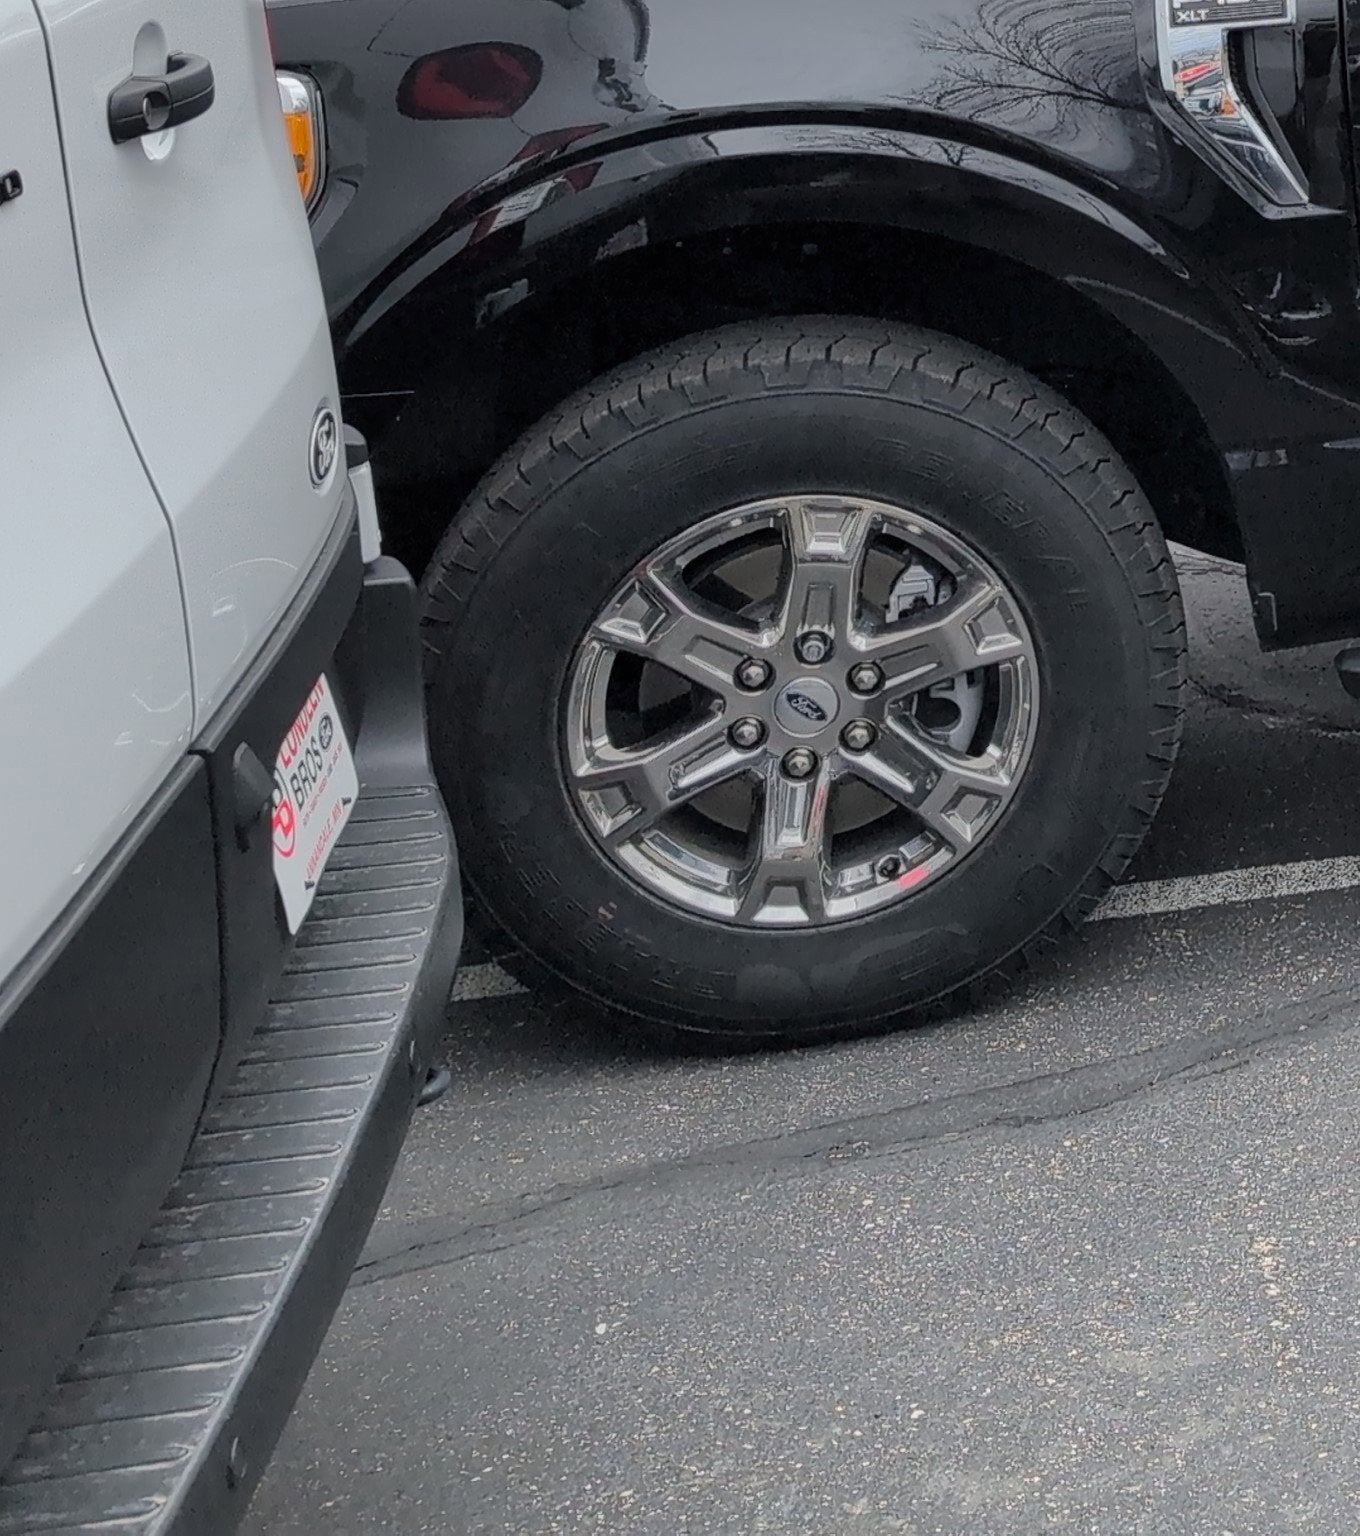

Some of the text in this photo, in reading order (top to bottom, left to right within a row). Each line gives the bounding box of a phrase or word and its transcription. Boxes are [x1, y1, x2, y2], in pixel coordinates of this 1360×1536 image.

[1175, 9, 1210, 24] XLT
[789, 695, 824, 720] Ford
[290, 735, 322, 811] BROS
